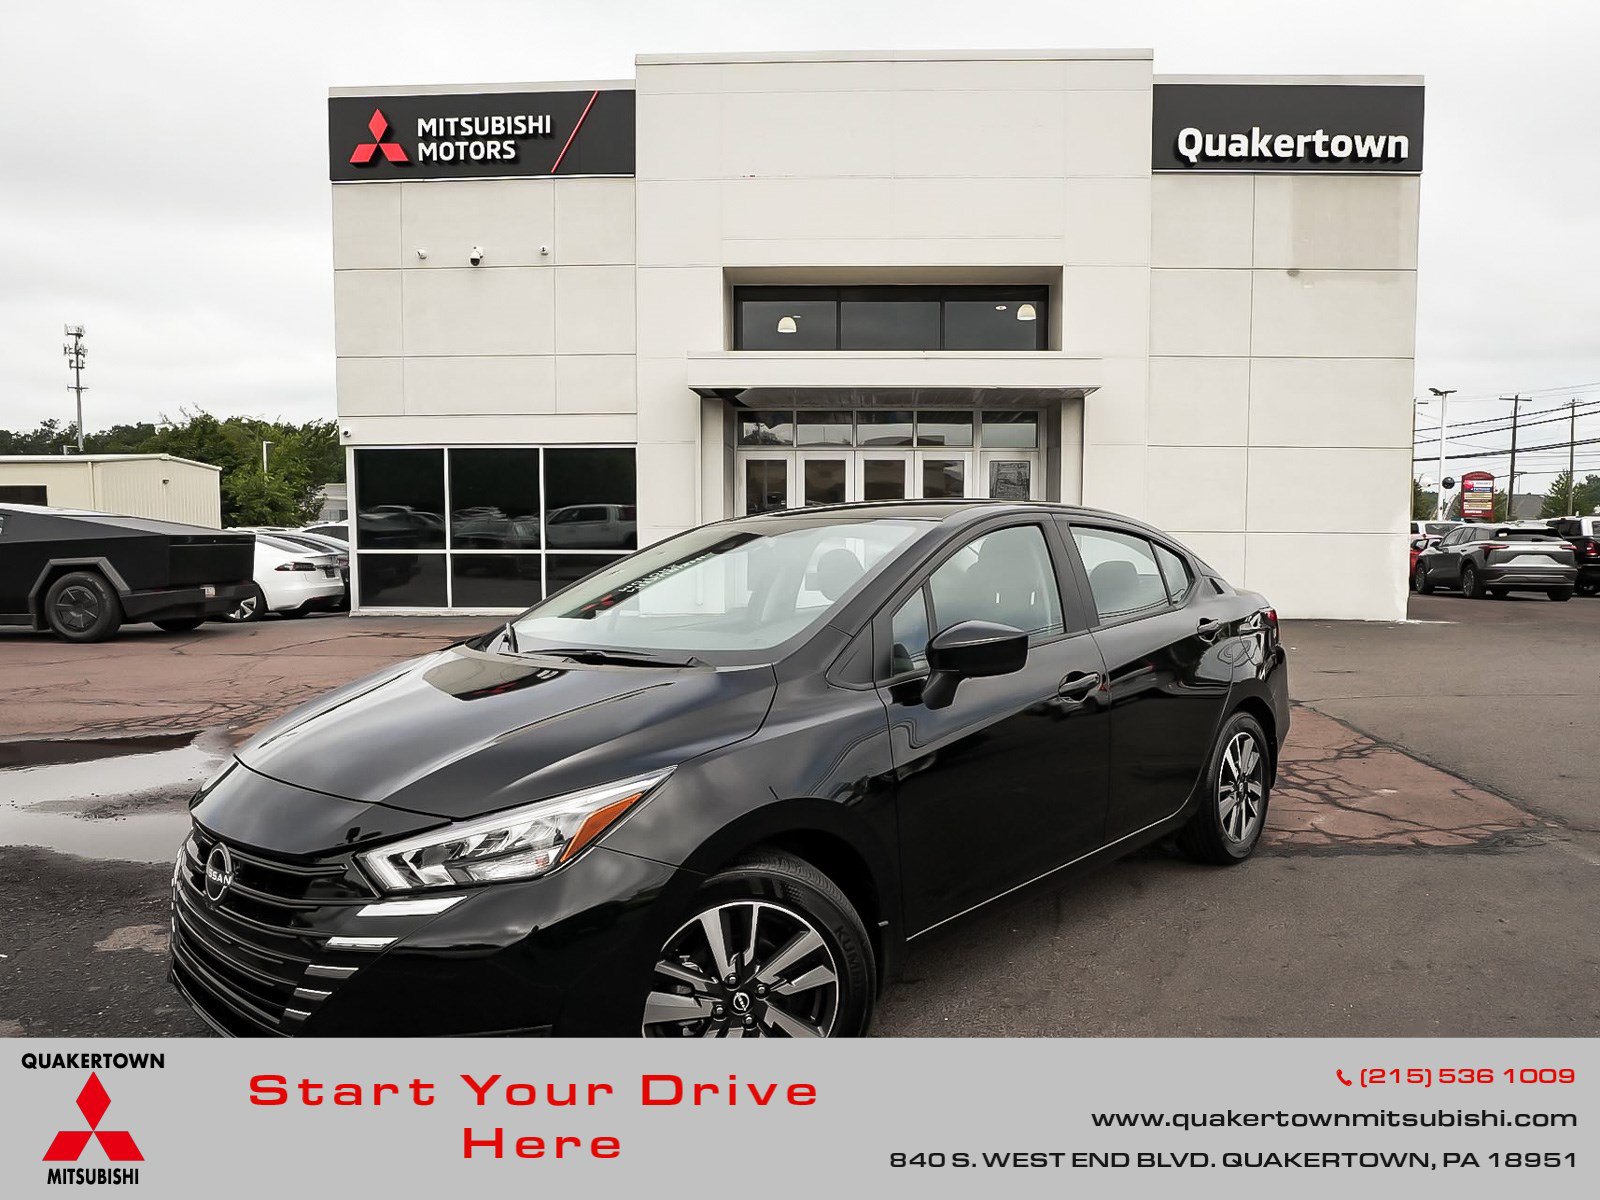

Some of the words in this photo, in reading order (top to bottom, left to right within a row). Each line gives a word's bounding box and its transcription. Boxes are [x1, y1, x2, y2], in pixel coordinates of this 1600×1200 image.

[417, 114, 551, 137] MITSUBISHI
[417, 140, 516, 162] MOTORS
[1177, 126, 1409, 163] Quakertown
[206, 867, 232, 886] SSAN
